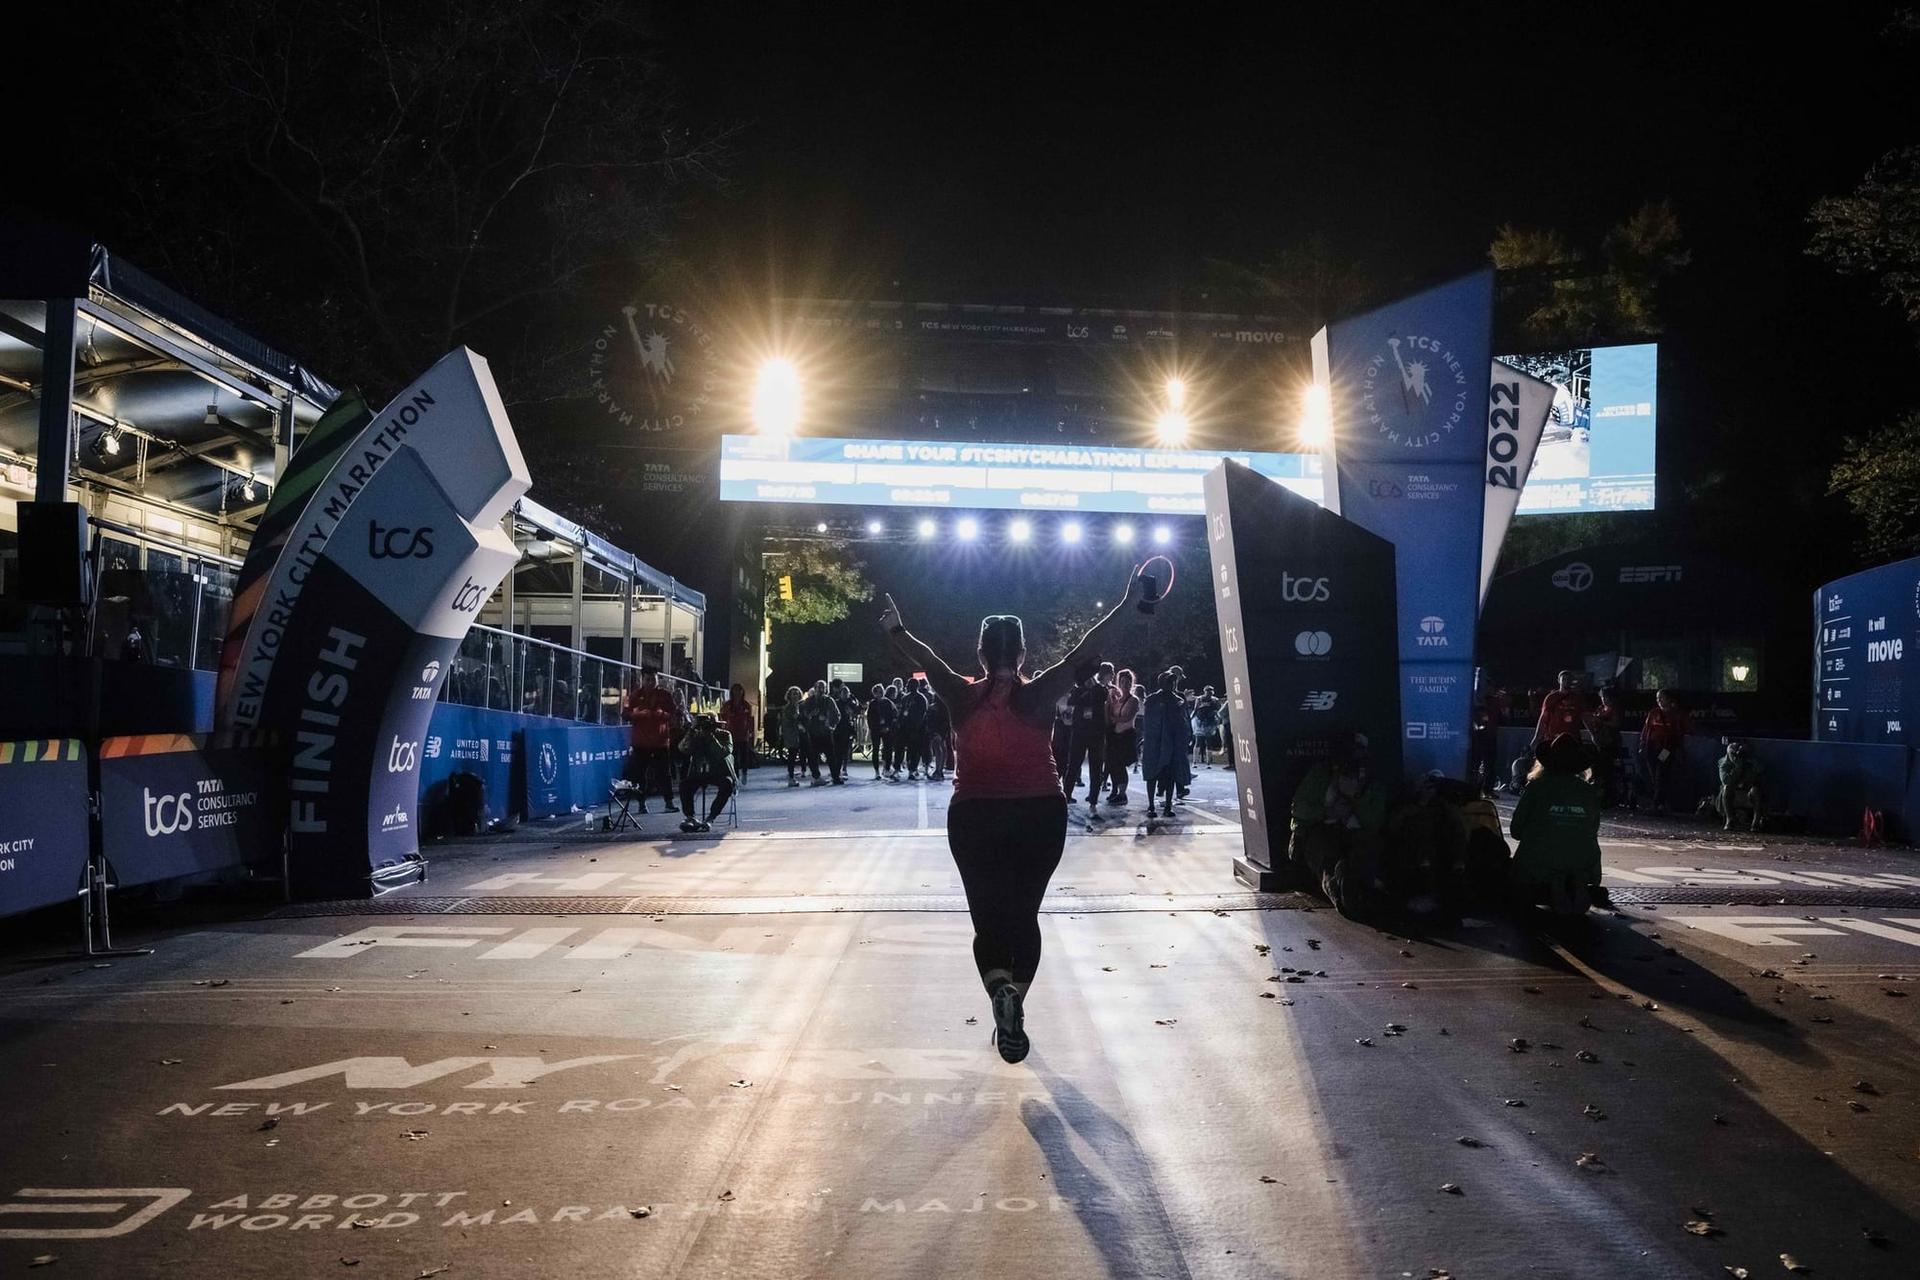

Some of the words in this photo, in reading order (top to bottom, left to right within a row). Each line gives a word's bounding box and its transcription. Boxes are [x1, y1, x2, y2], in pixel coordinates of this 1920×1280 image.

[645, 303, 687, 324] TCS
[1235, 329, 1284, 343] move
[1406, 335, 1442, 352] TCS
[1442, 351, 1467, 384] NEW
[1363, 354, 1400, 443] MARATHON
[1443, 391, 1467, 433] YORK
[1404, 432, 1440, 447] CITY
[1488, 382, 1520, 490] 2022
[1408, 474, 1430, 483] TATA
[253, 589, 298, 663] YORK
[289, 523, 328, 585] CITY
[324, 389, 438, 521] MARATHON
[368, 519, 434, 560] tcs
[1619, 564, 1683, 584] ESPN
[451, 576, 488, 613] tcs
[1281, 570, 1331, 602] tcs
[1415, 636, 1449, 646] TATA
[1867, 637, 1904, 663] move
[411, 686, 432, 700] TATA
[290, 626, 368, 833] FINISH
[388, 734, 418, 773] tcs
[456, 739, 480, 750] UNITED
[449, 750, 480, 761] AIRLINES
[197, 779, 224, 793] TATA
[144, 787, 193, 837] tcs
[197, 792, 258, 812] CONSULTANCY
[198, 812, 238, 829] SERVICES
[12, 838, 35, 852] CITY
[155, 1102, 335, 1117] NEW
[343, 1101, 545, 1117] YORK
[783, 1091, 1062, 1110] RUNNER
[207, 1190, 470, 1210] ABBOTT
[187, 1211, 427, 1232] WORLD
[859, 1196, 1092, 1214] MAJOR
